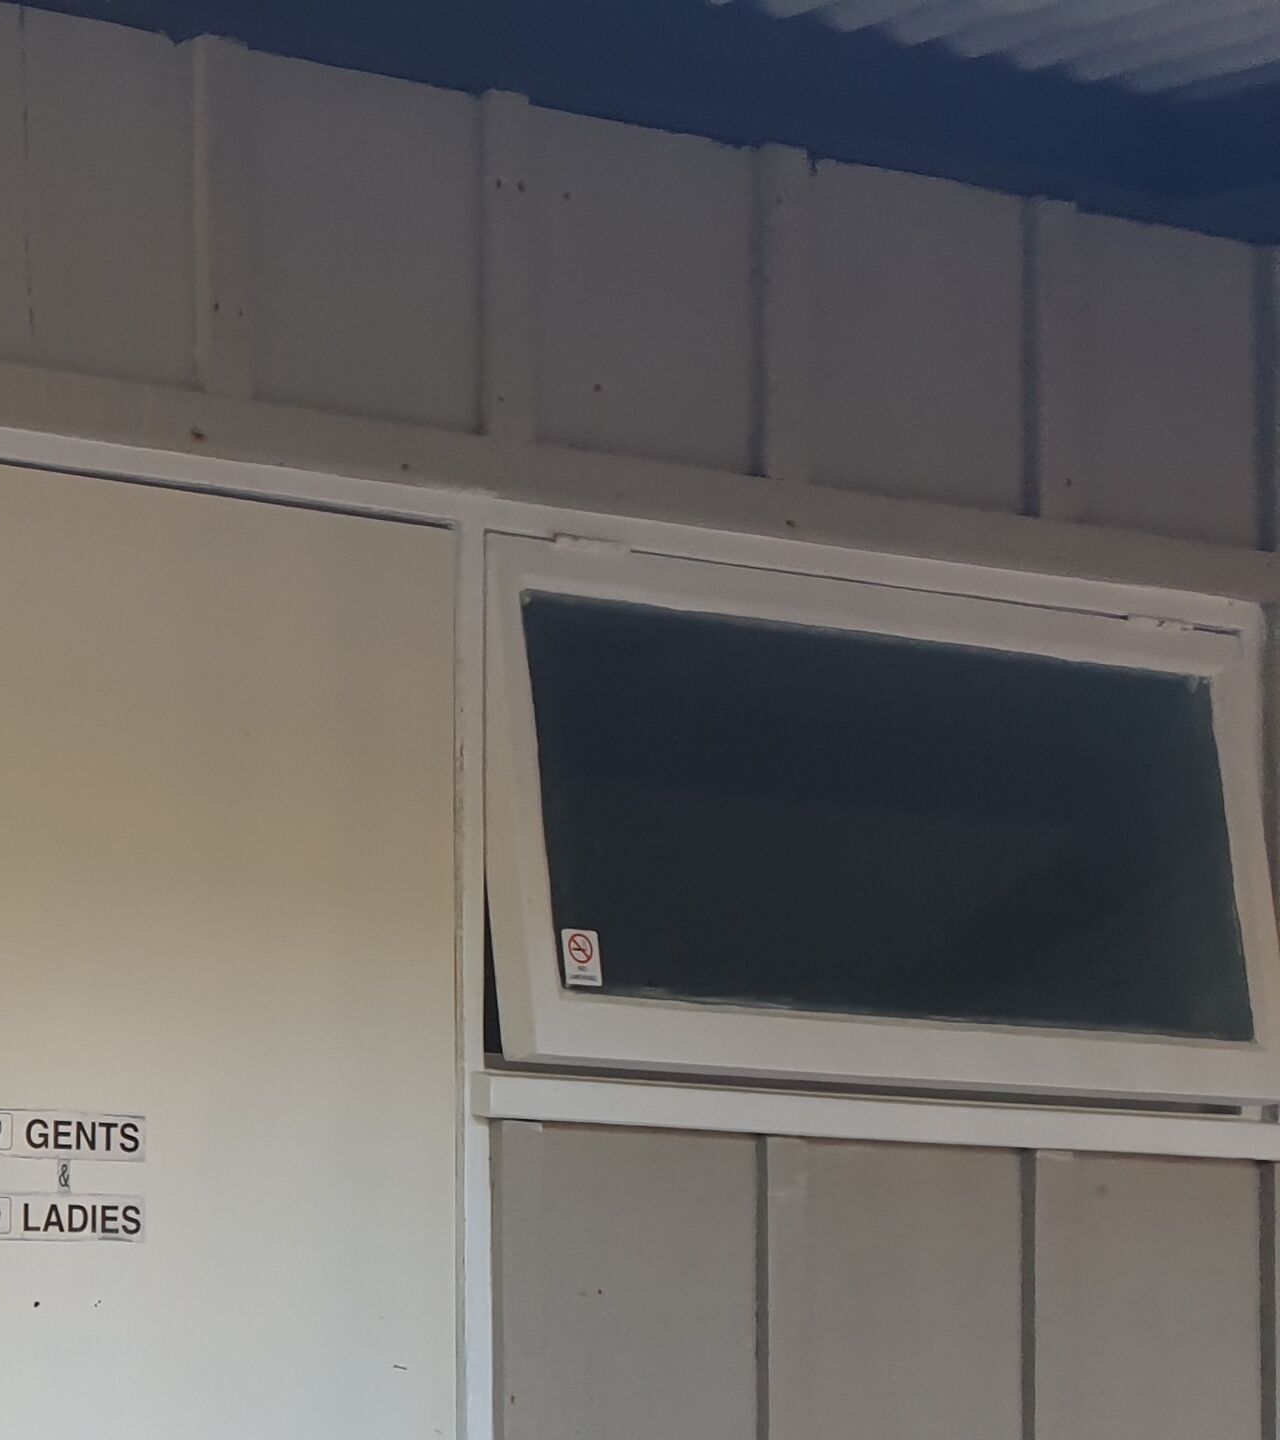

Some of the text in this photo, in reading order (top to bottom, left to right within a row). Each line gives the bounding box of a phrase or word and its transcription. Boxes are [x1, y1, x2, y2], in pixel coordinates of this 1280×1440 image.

[25, 1118, 140, 1153] GENTS
[58, 1163, 70, 1188] &
[23, 1202, 141, 1235] LADIES
